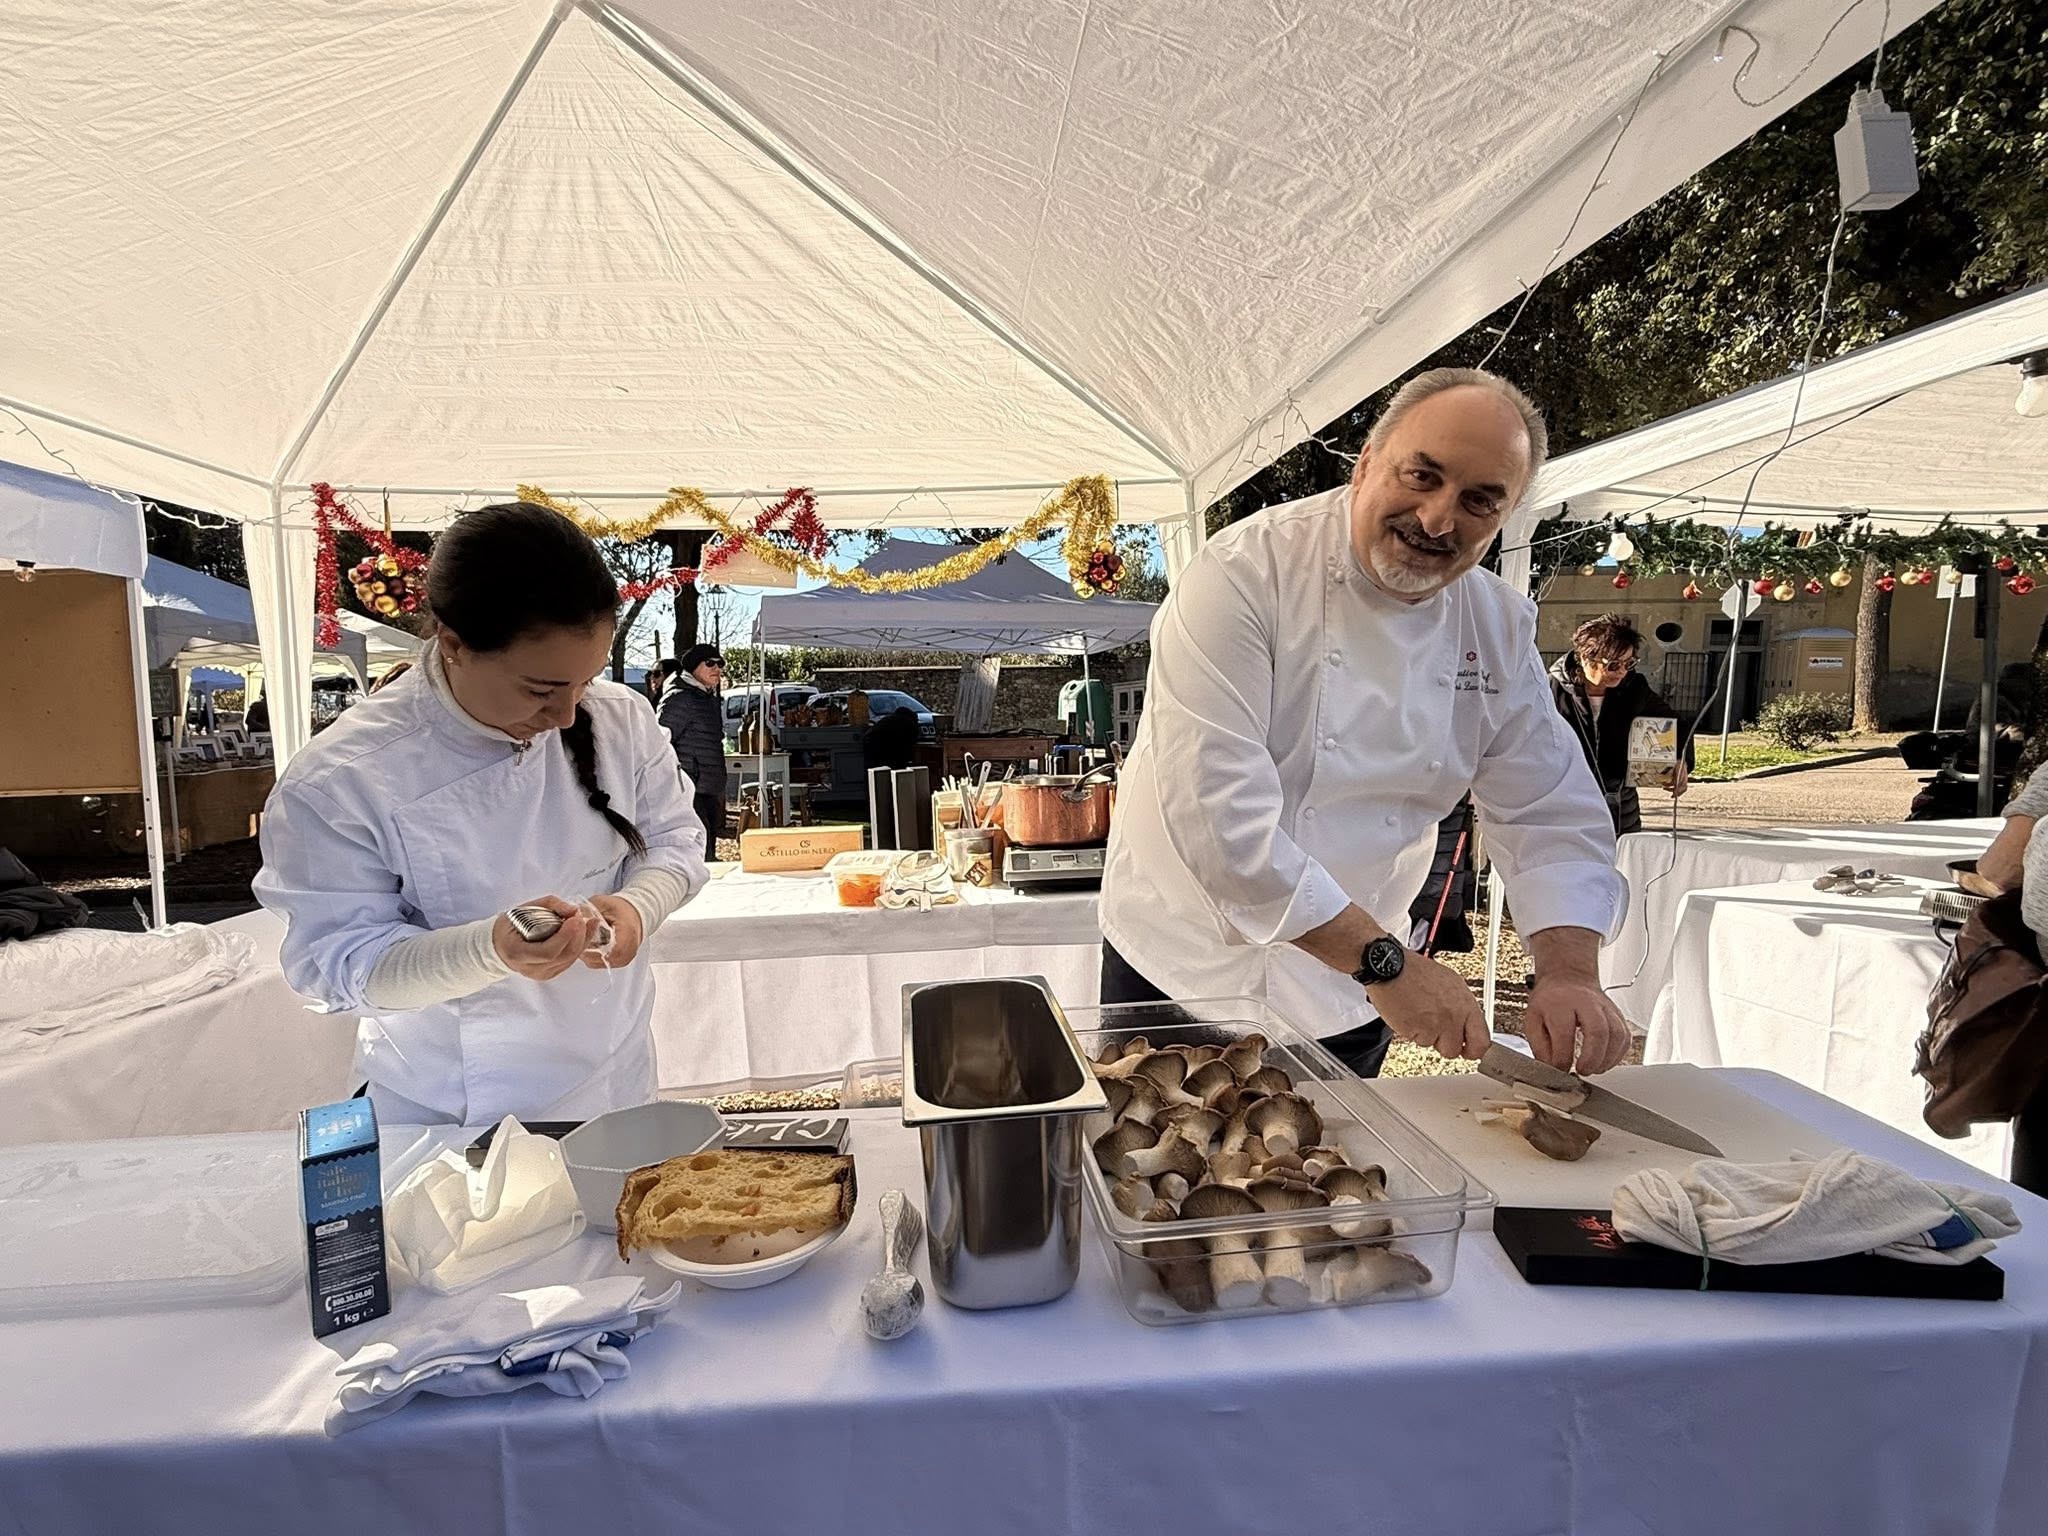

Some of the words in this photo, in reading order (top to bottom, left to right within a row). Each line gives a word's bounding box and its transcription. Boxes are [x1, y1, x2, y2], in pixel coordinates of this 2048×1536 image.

[760, 849, 799, 857] CASTELLO
[812, 847, 835, 855] NERO
[333, 1316, 340, 1326] 1
[344, 1312, 360, 1324] kg
